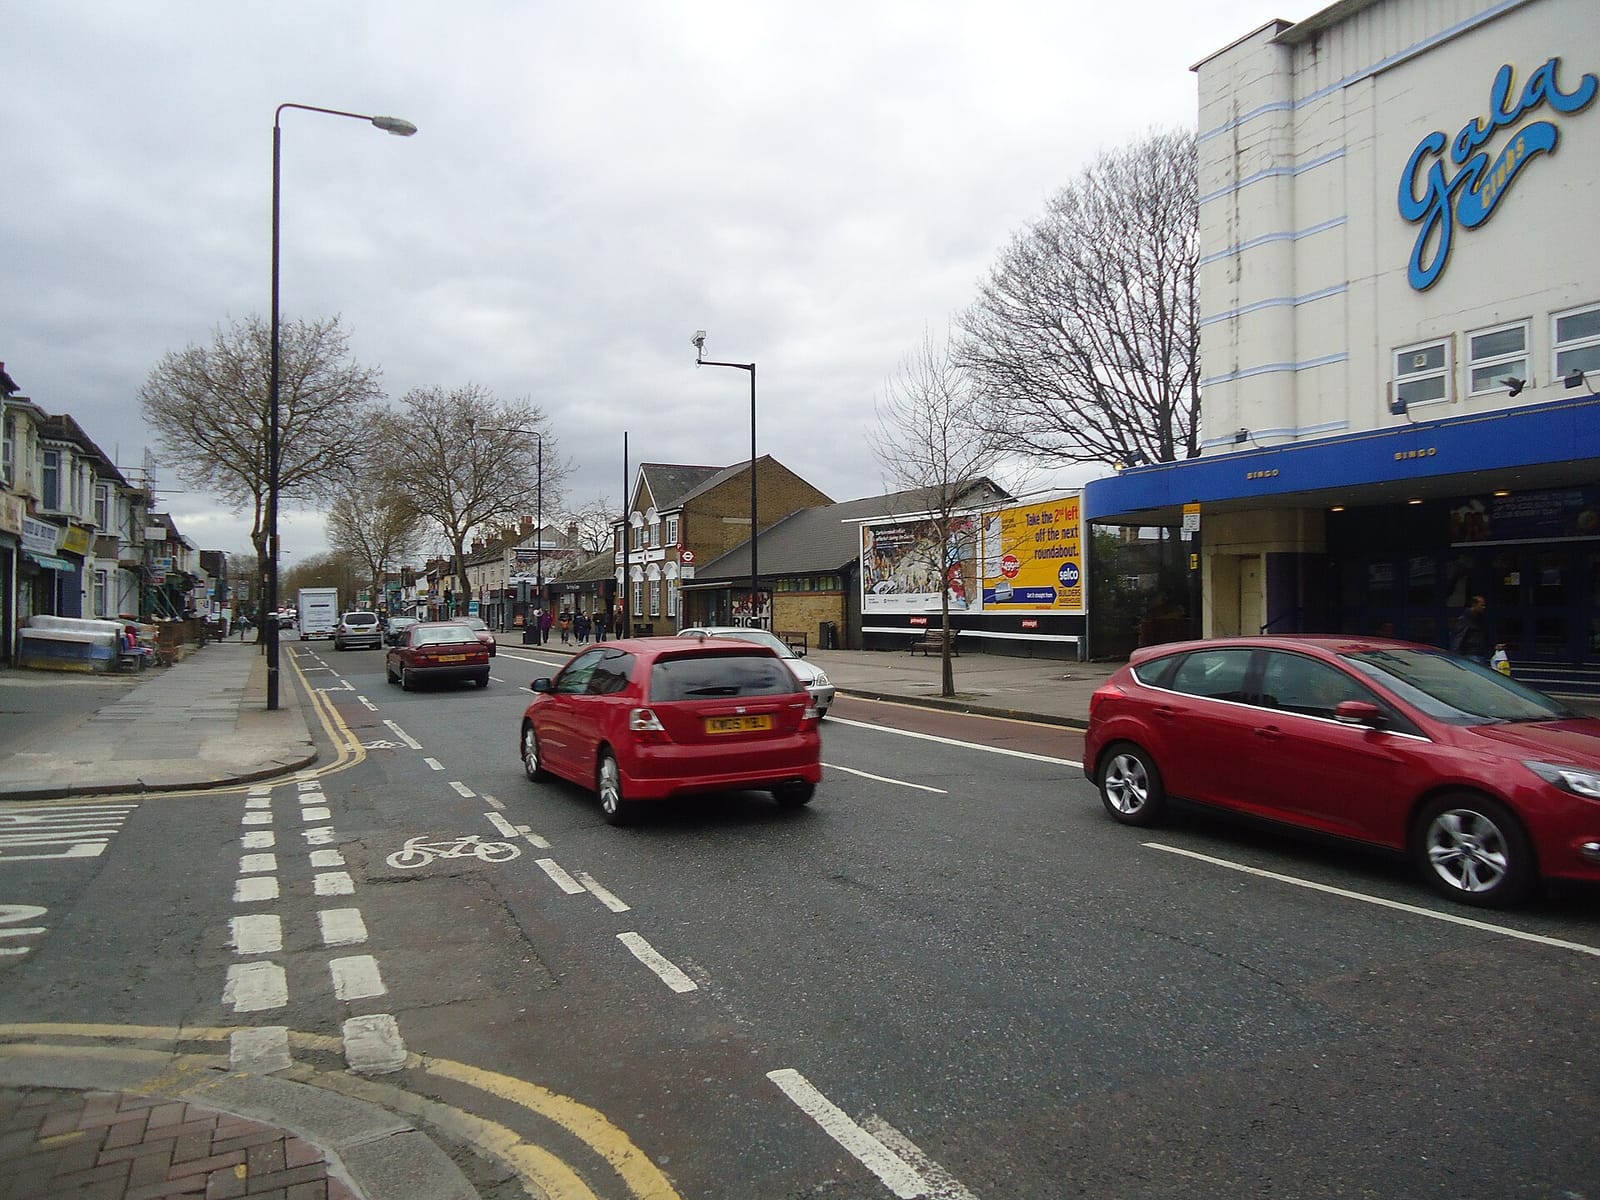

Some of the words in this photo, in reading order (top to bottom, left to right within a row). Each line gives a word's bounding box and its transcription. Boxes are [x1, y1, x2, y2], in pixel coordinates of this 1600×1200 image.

[1398, 56, 1599, 292] Gala
[1393, 447, 1436, 461] BINGO
[1025, 512, 1040, 527] Take
[1041, 511, 1054, 524] the
[1065, 505, 1078, 520] left
[1035, 528, 1047, 542] off
[1047, 526, 1060, 541] the
[1061, 524, 1079, 539] next
[1034, 543, 1079, 559] roundabout.
[1059, 567, 1079, 581] selco
[732, 615, 771, 630] RIGT
